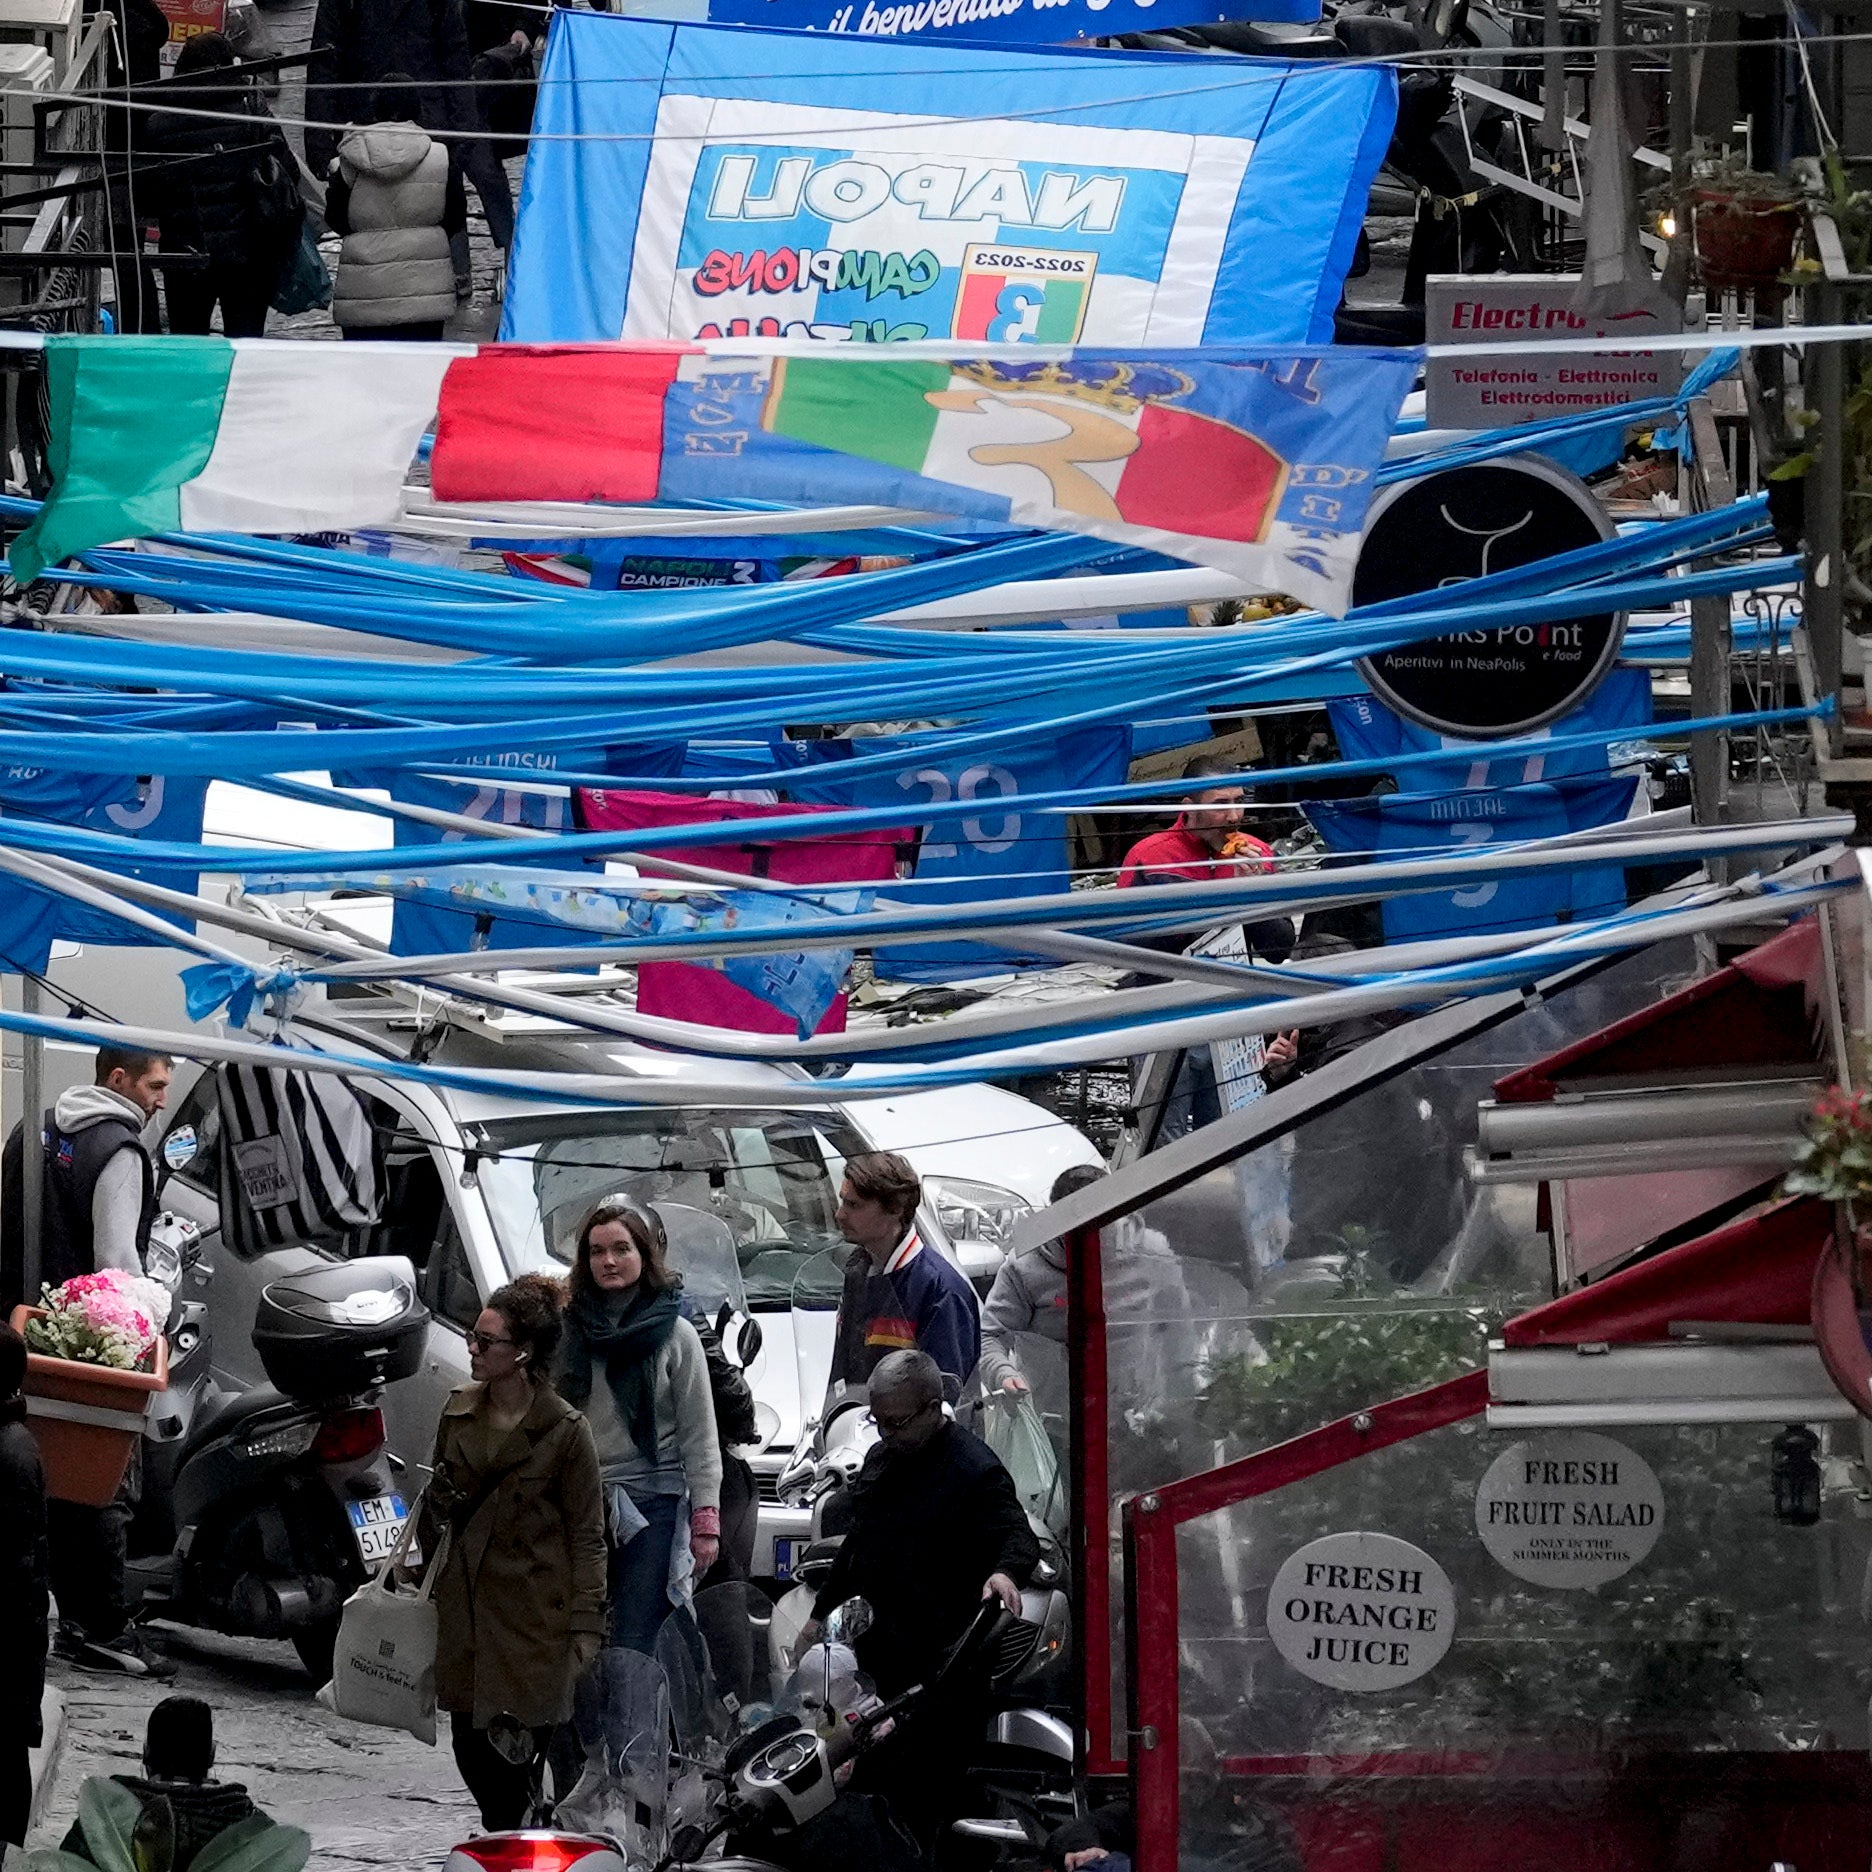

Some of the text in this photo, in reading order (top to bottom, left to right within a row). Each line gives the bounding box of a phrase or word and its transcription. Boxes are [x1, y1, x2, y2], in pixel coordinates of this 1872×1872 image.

[829, 4, 854, 33] il
[1451, 368, 1538, 384] Telefonia
[1557, 368, 1658, 384] Elettronica
[1480, 390, 1632, 406] Elettrodomestici
[620, 573, 728, 589] CAMPIONE
[732, 560, 757, 585] 3
[1384, 653, 1527, 672] Aperitivi in NeaPolis
[1553, 649, 1582, 661] food
[895, 763, 1022, 859] 20
[1524, 1460, 1620, 1486] FRESH
[361, 1499, 387, 1523] EM
[1488, 1500, 1655, 1527] FRUIT SALAD
[361, 1524, 404, 1553] 514
[1530, 1538, 1613, 1549] ONLY IN THE
[1512, 1550, 1631, 1562] SUMMER MONTHS
[1304, 1562, 1423, 1595] FRESH
[1284, 1597, 1438, 1632] ORANGE
[1306, 1636, 1410, 1666] JUICE
[350, 1657, 378, 1678] TOUCH
